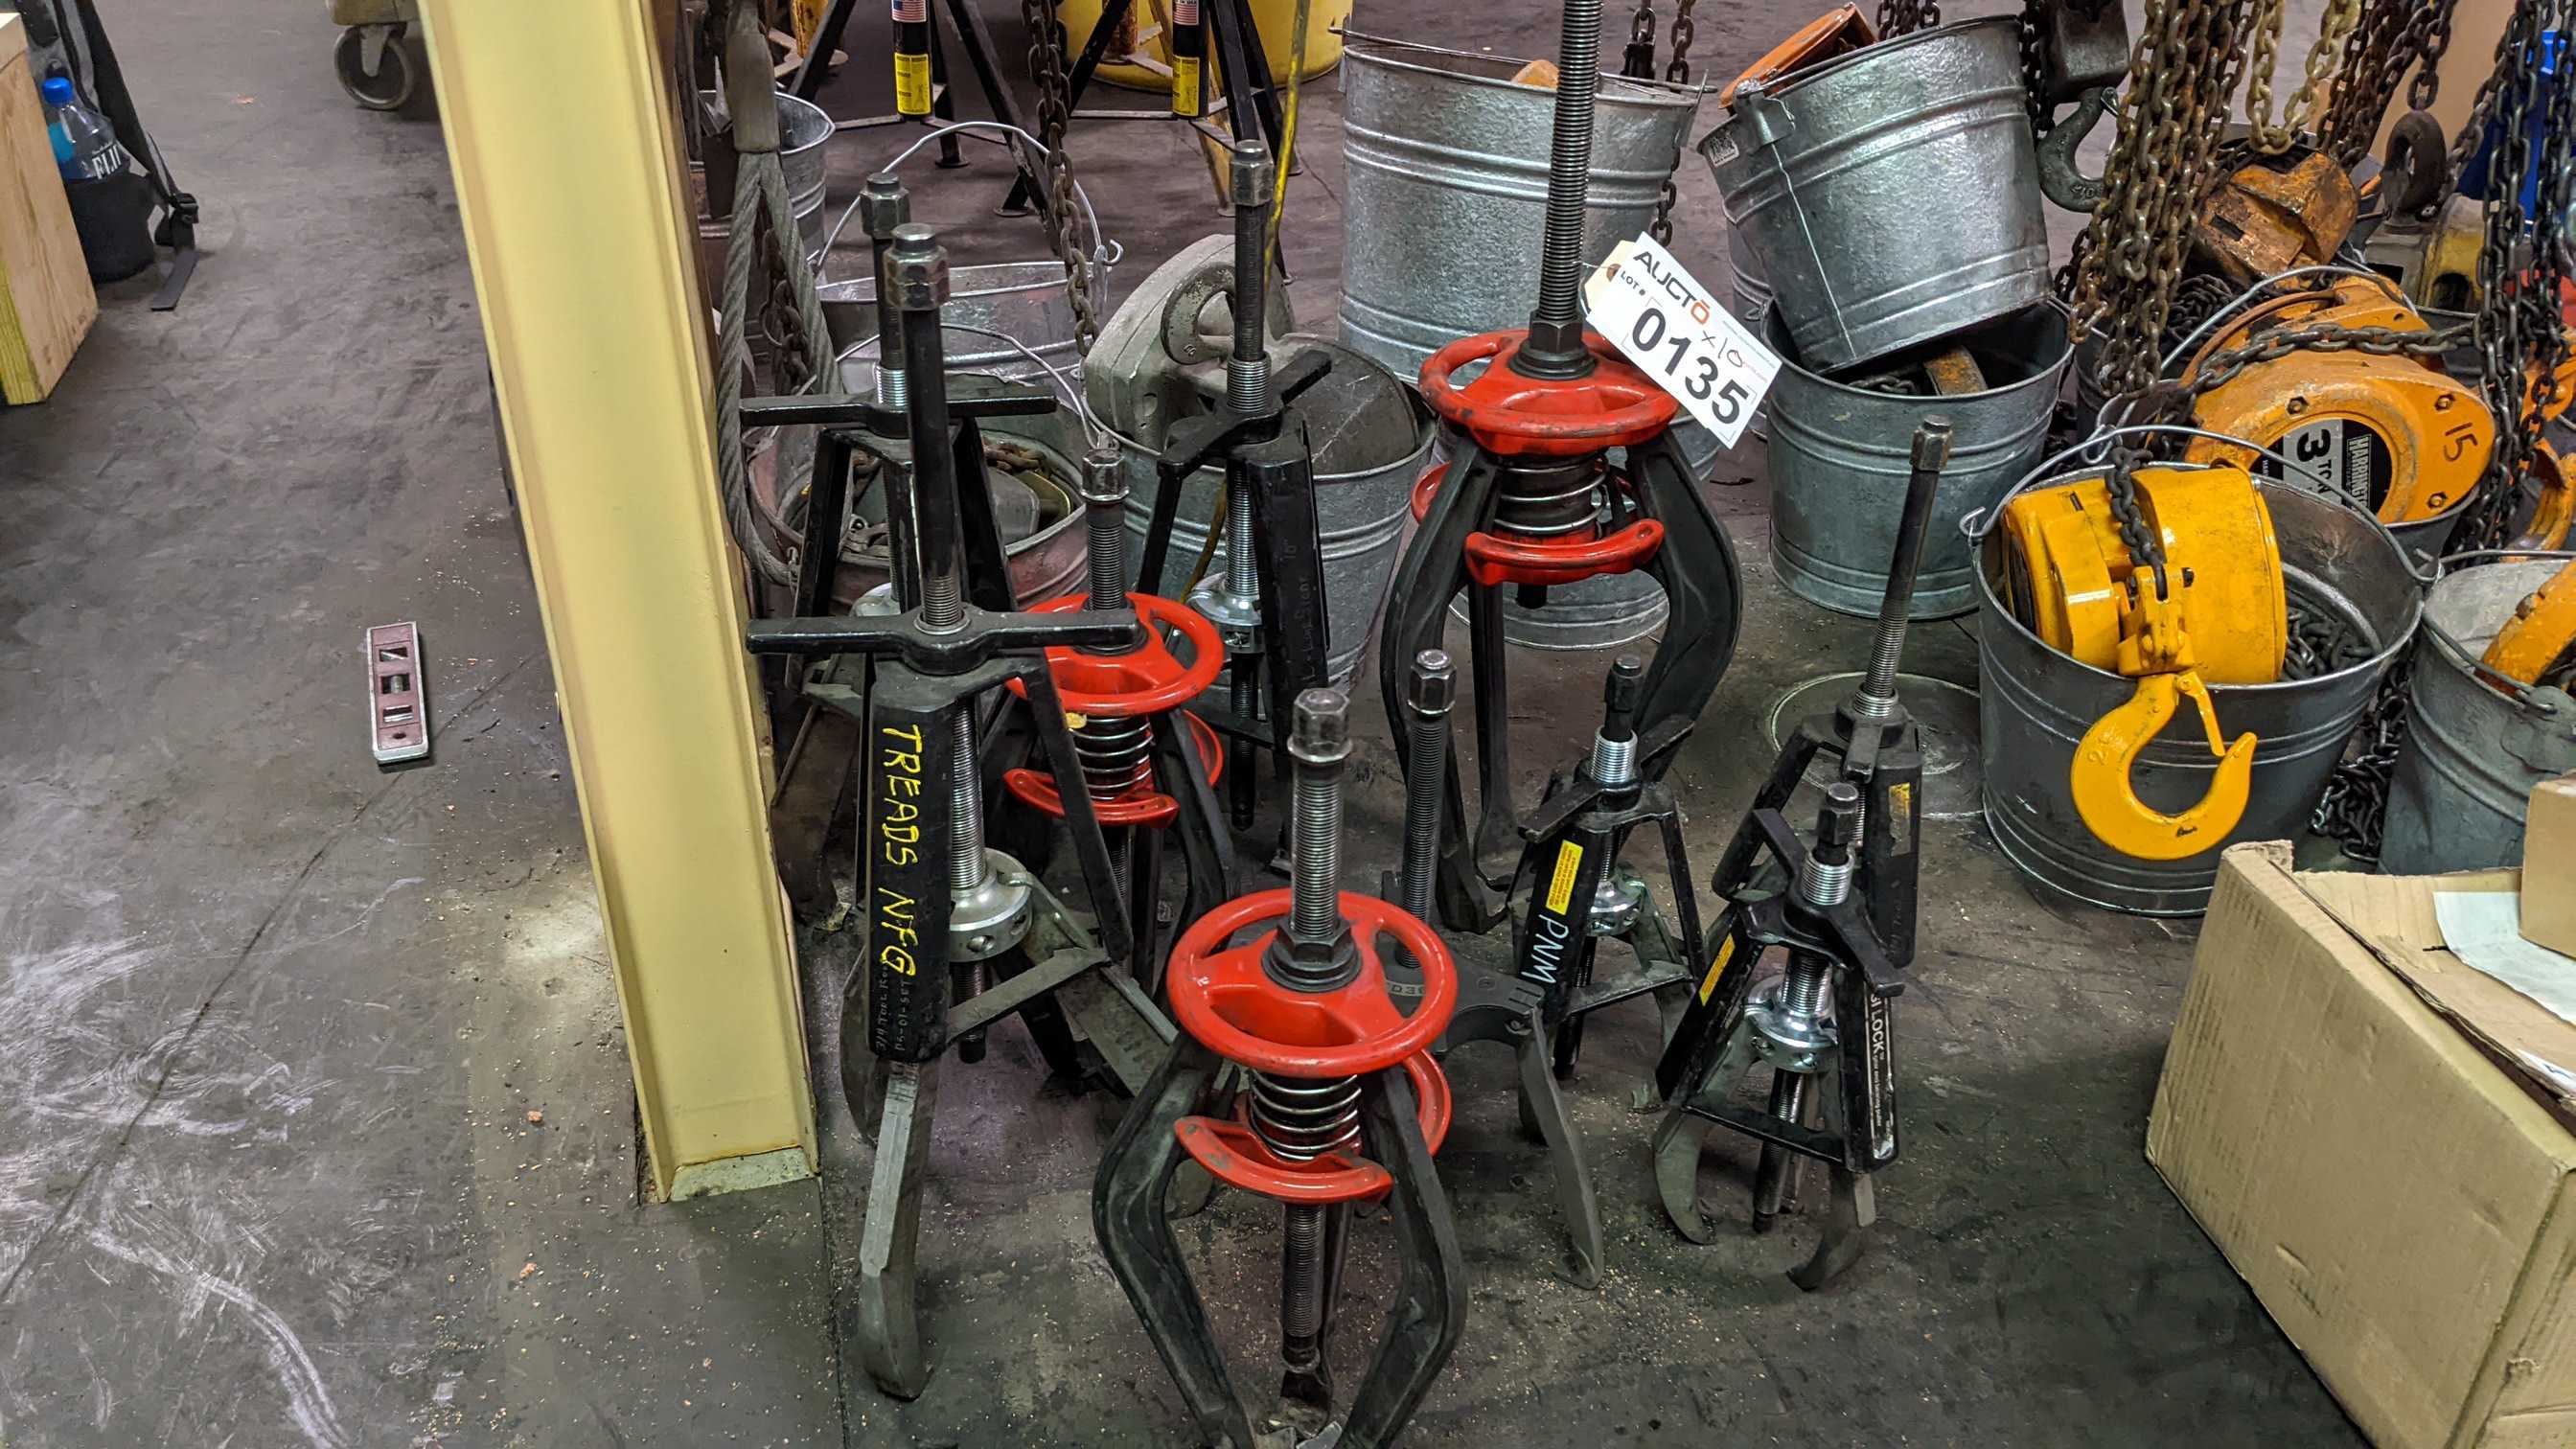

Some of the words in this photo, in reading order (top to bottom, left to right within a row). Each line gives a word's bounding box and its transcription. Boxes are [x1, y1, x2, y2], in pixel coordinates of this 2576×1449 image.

[92, 145, 122, 179] FIJI
[1620, 270, 1639, 289] LOT
[1632, 307, 1749, 425] 0135
[2296, 428, 2331, 462] 3
[2443, 422, 2478, 462] 15
[2349, 436, 2369, 511] HARRINGTO
[882, 724, 923, 866] TREADS
[878, 886, 919, 977] NFG
[1521, 913, 1569, 984] PNM
[1872, 1009, 1885, 1054] LOCK
